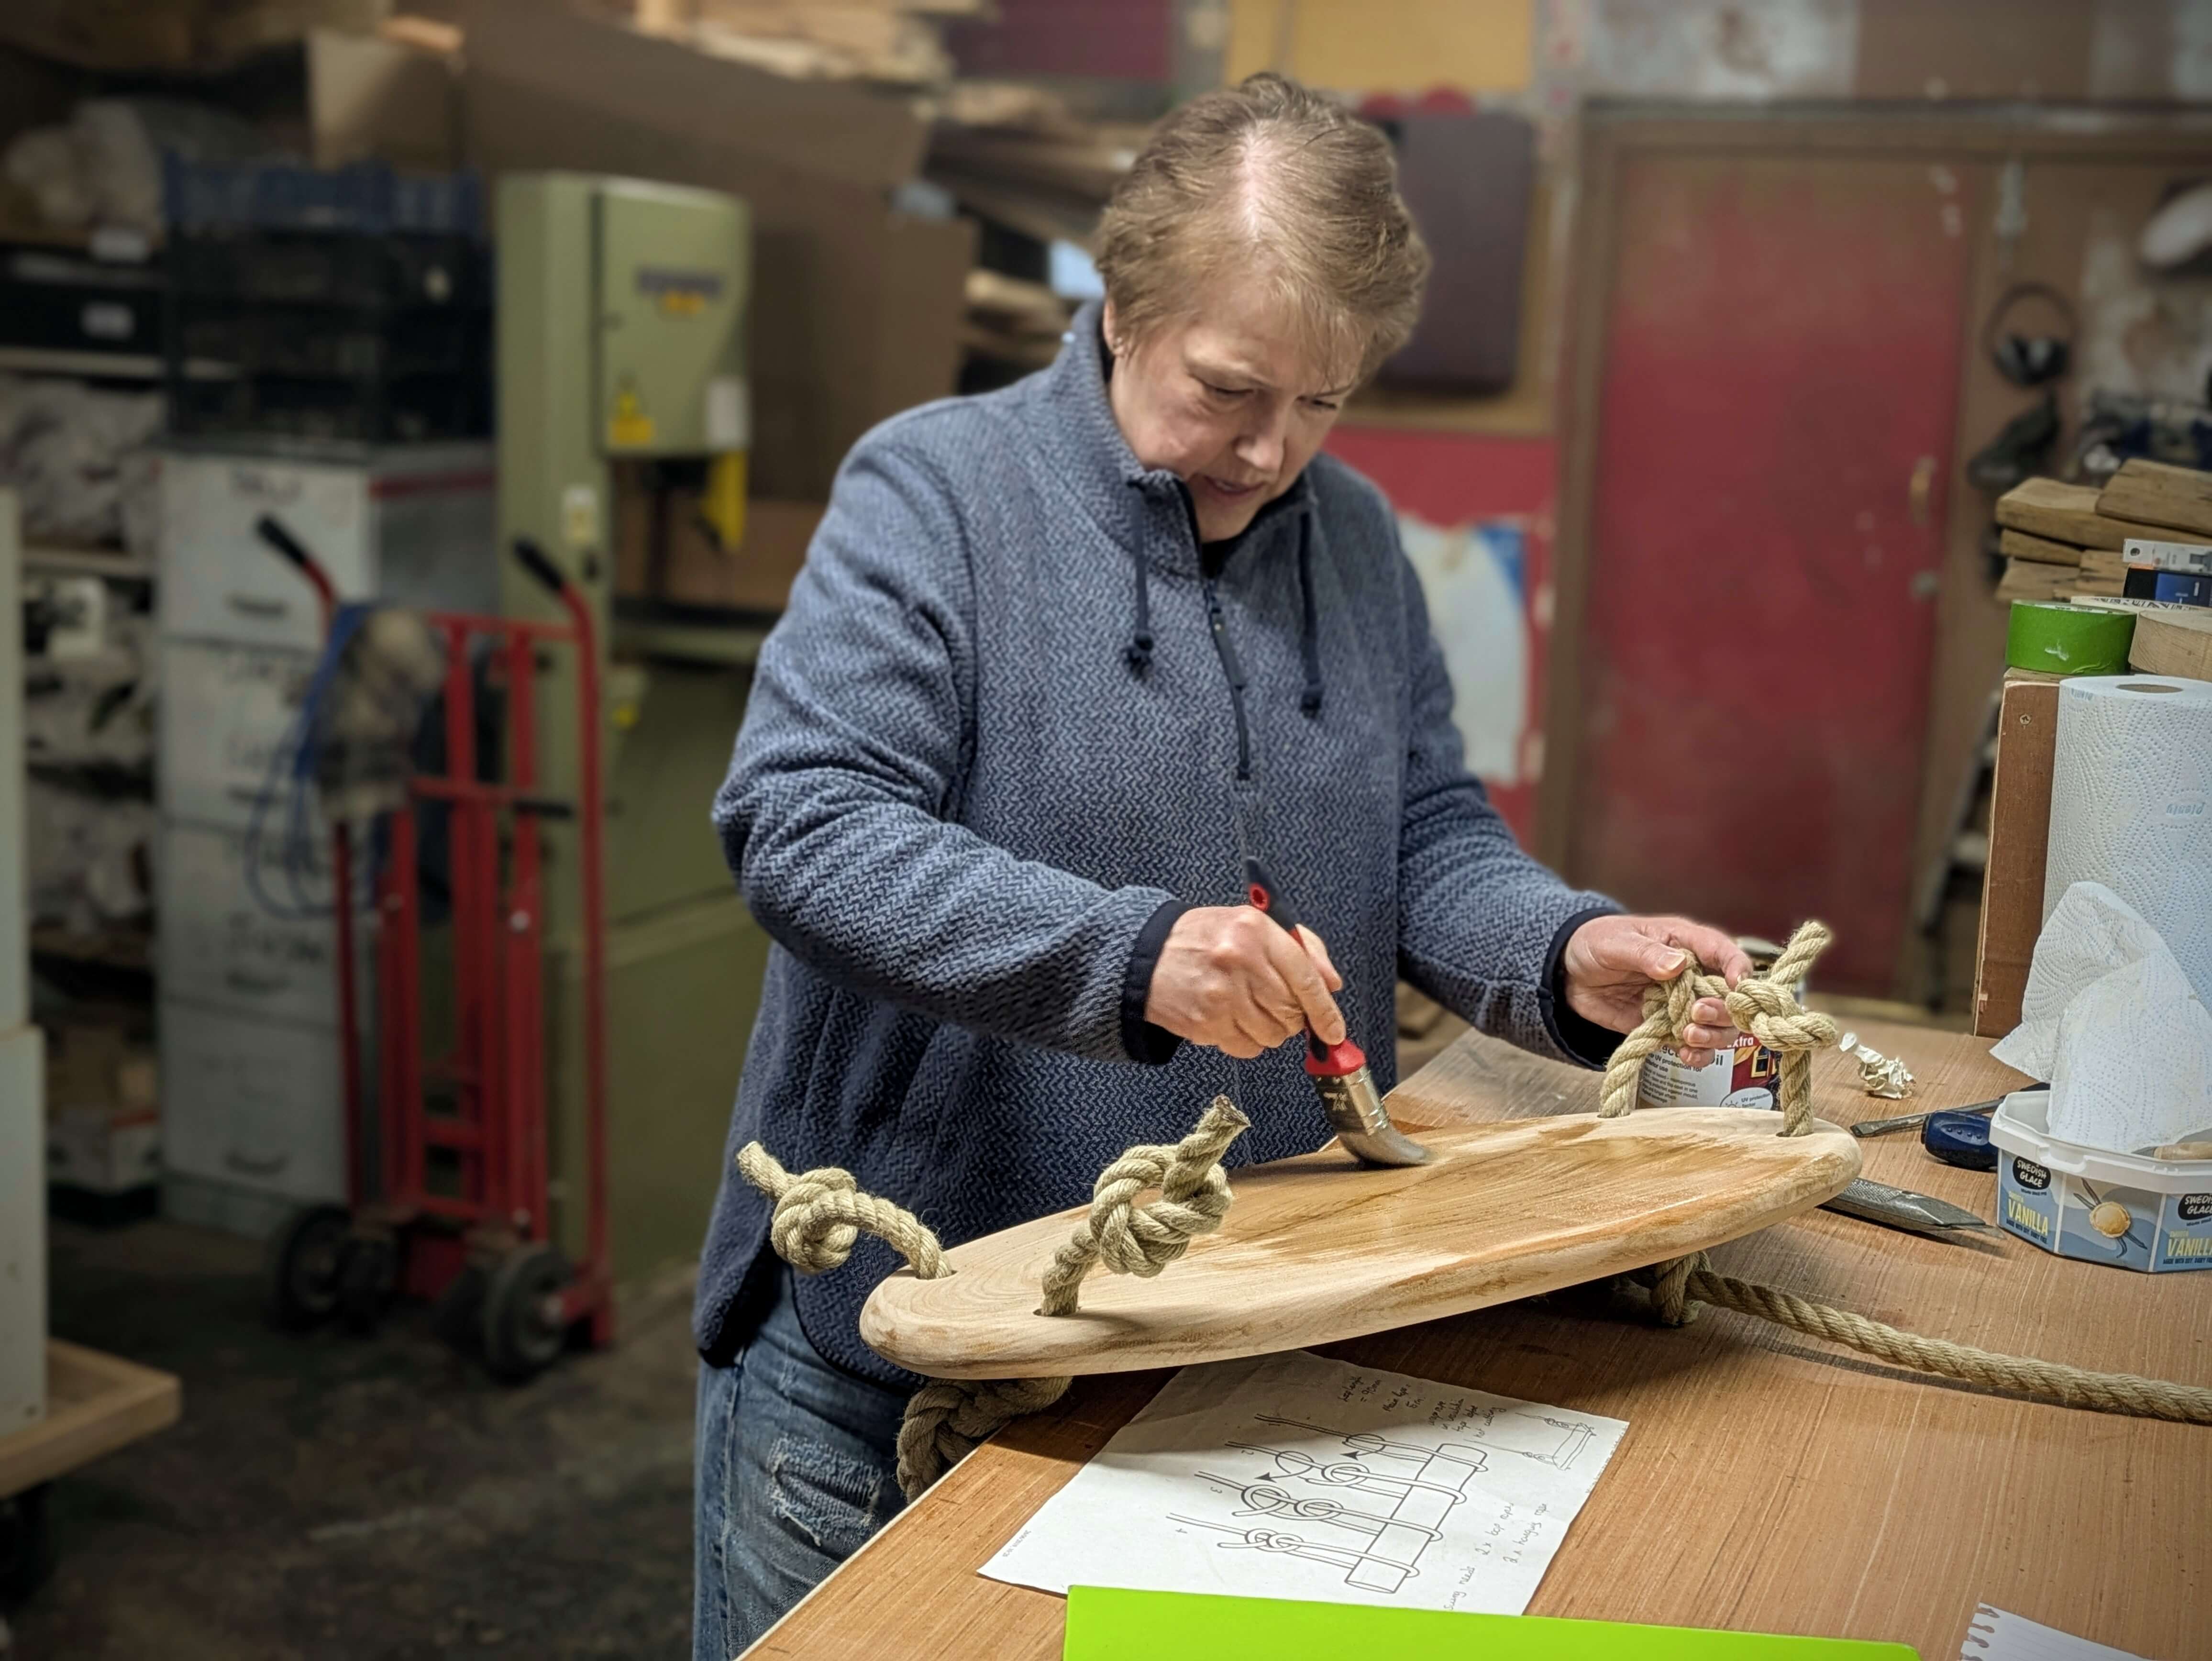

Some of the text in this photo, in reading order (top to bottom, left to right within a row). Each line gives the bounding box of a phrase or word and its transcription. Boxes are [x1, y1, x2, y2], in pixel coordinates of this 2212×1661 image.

[2166, 802, 2206, 816] plenty
[1727, 1036, 1754, 1048] xtra
[1662, 1058, 1691, 1071] protection
[2017, 1160, 2047, 1179] SWEDISH
[2020, 1171, 2043, 1187] GLACE
[2008, 1198, 2048, 1237] VANILLA
[1482, 1406, 1507, 1427] cutting
